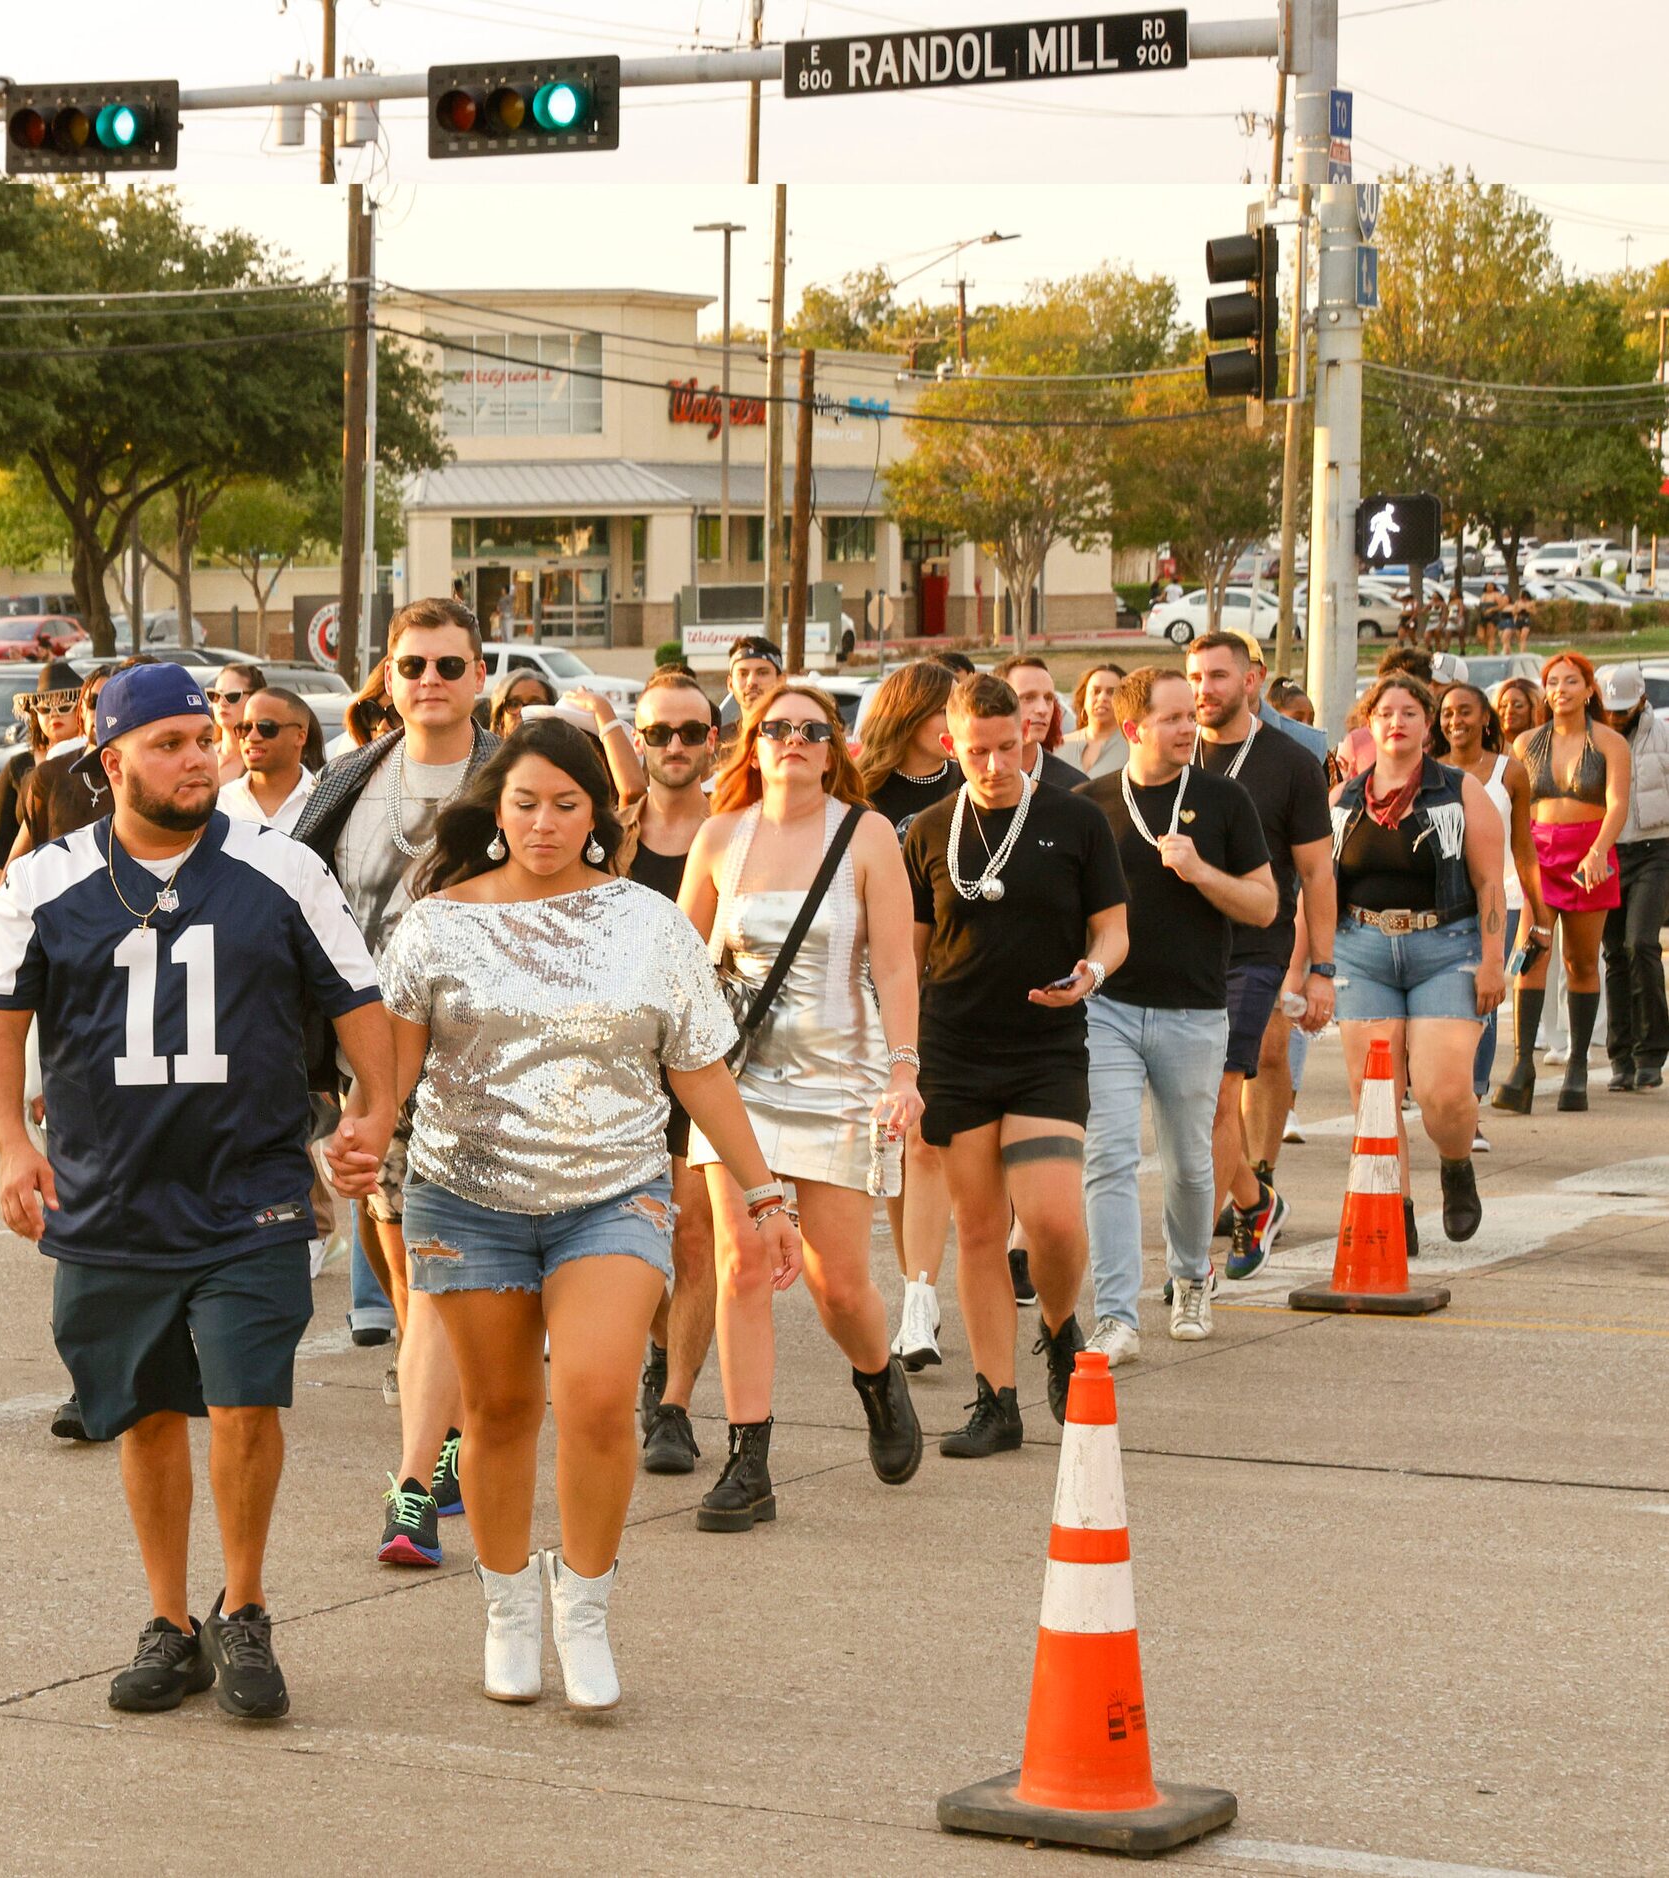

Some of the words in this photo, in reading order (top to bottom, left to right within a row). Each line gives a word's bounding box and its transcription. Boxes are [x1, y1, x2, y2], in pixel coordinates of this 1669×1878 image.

[810, 44, 821, 66] E
[848, 32, 1007, 88] RANDOL
[1028, 22, 1120, 75] MILL
[1141, 18, 1166, 41] RD
[1135, 41, 1172, 66] 900
[798, 68, 832, 92] 800
[1335, 99, 1347, 130] TO
[668, 376, 767, 440] Walgreen
[113, 923, 229, 1086] 11
